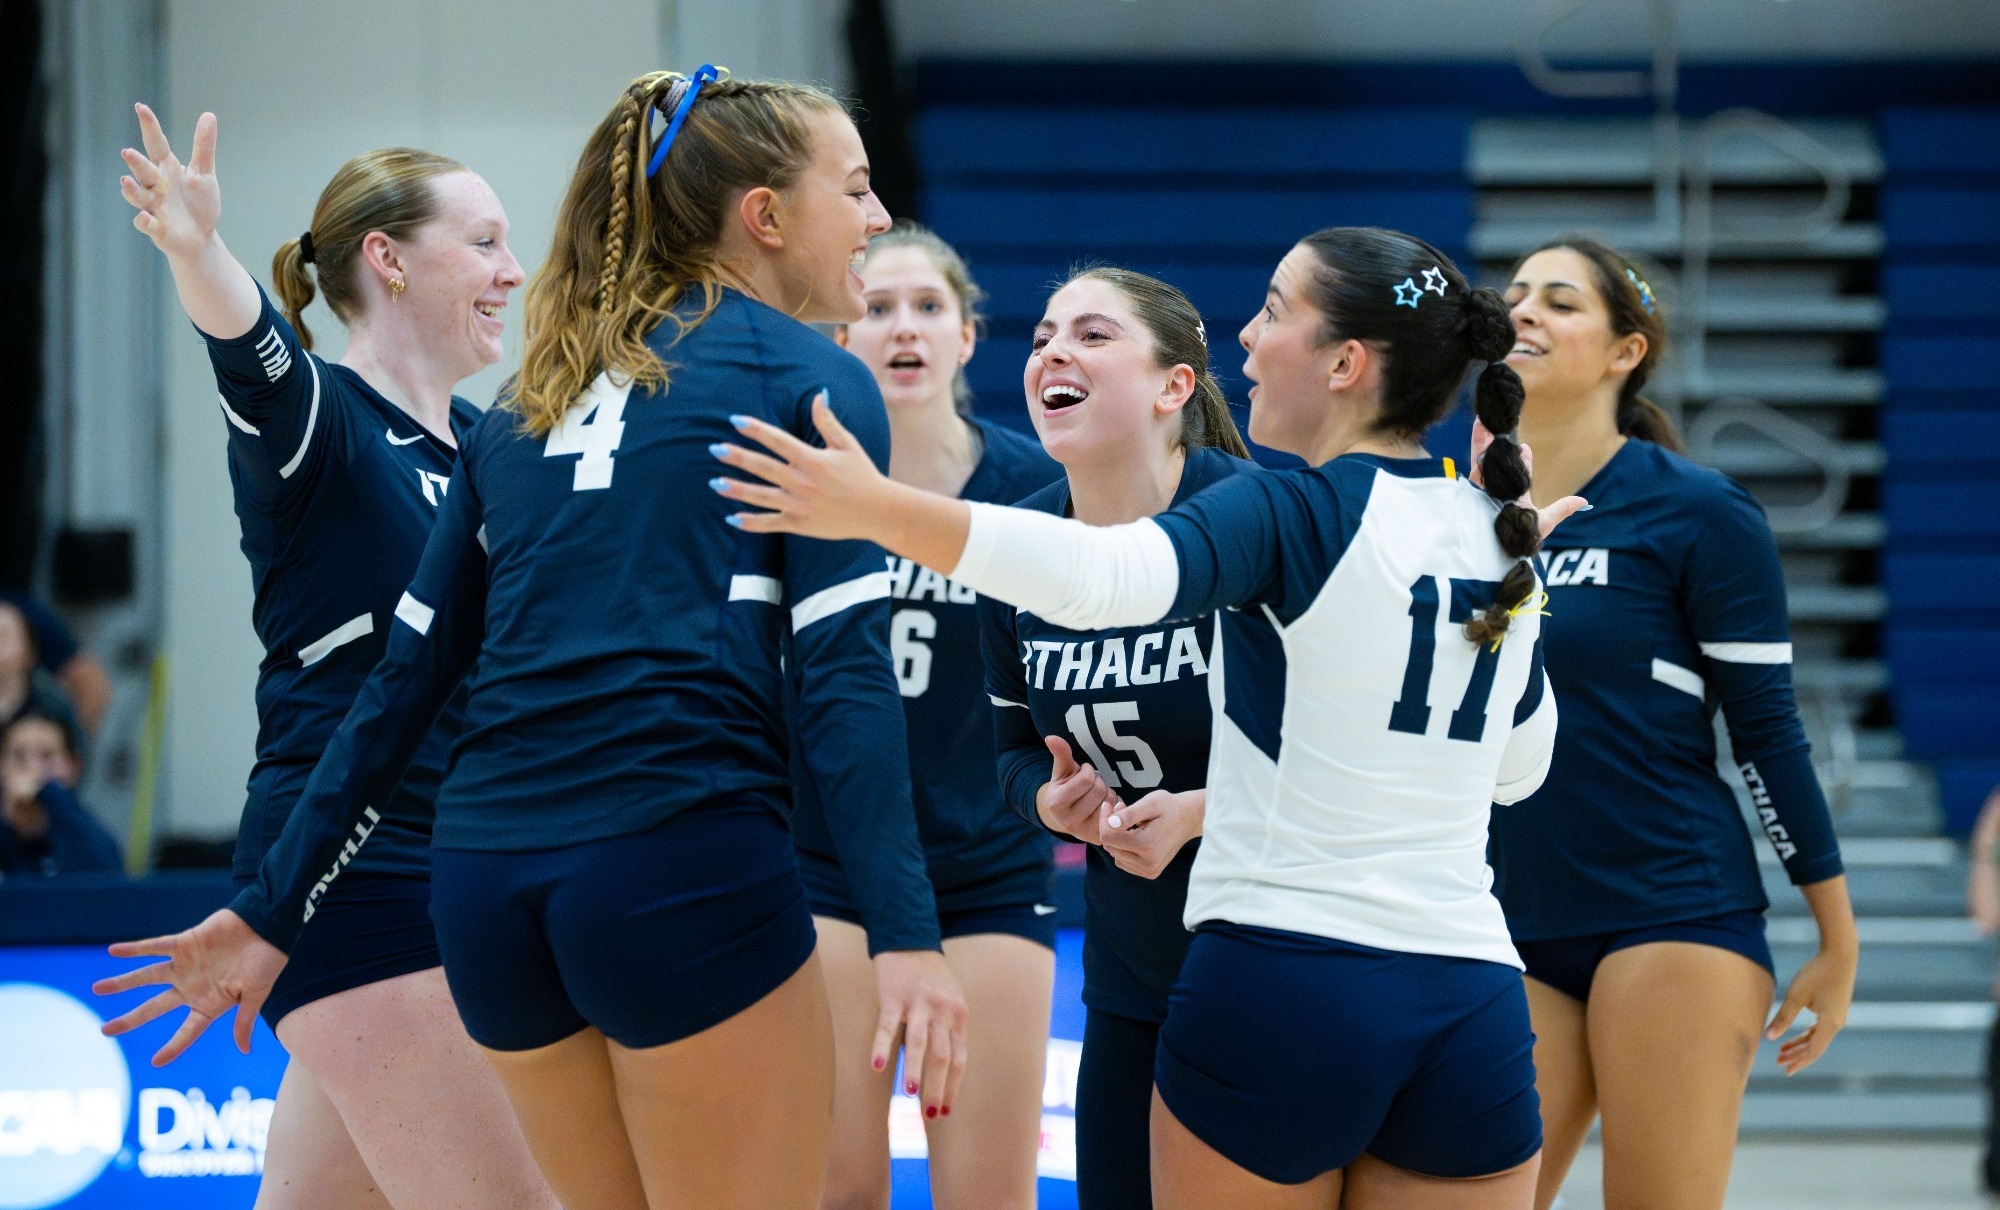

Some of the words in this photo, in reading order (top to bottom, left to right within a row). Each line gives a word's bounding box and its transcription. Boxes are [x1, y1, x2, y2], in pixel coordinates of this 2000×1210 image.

[543, 362, 635, 491] 4
[890, 608, 937, 698] 6
[1022, 626, 1209, 691] ITHACA
[1388, 574, 1506, 743] 17
[1065, 701, 1164, 788] 15
[1740, 761, 1798, 861] ITHACA
